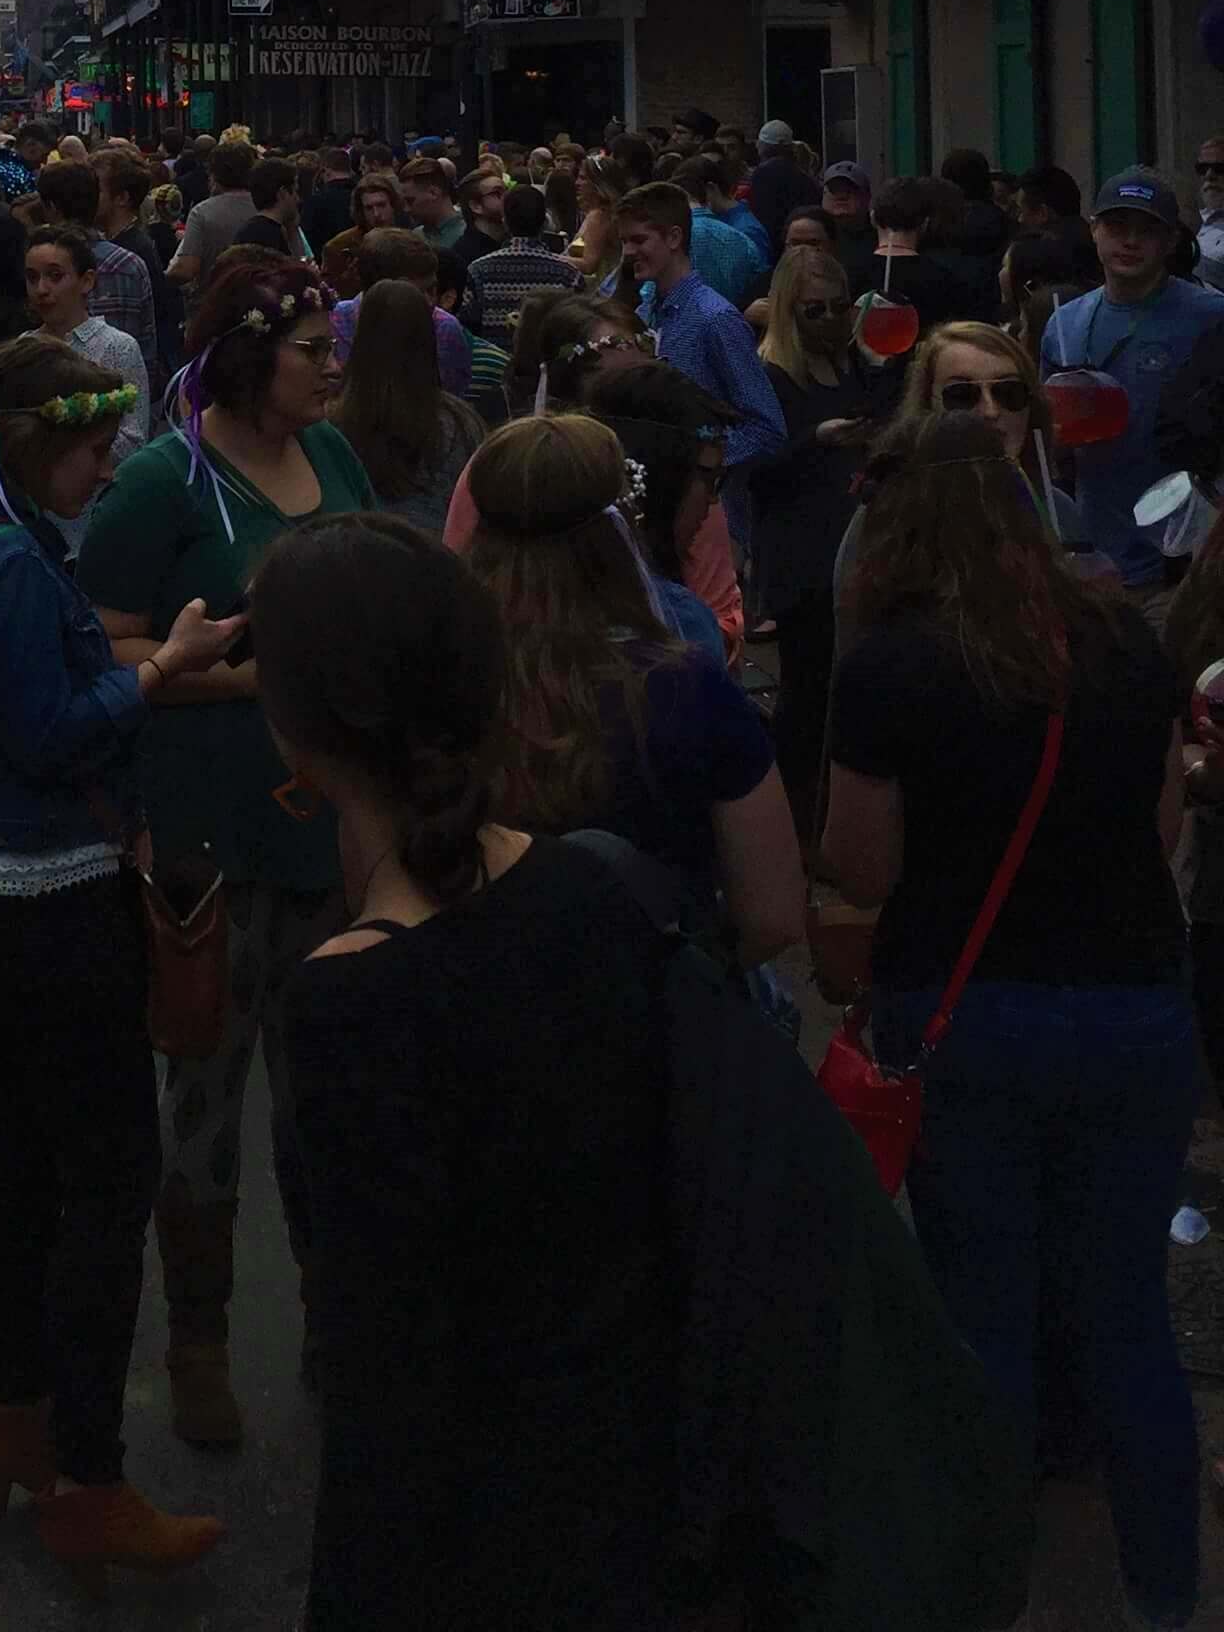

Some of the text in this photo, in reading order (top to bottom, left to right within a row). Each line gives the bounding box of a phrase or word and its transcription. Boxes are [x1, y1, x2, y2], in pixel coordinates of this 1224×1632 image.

[337, 24, 432, 41] BOURBON
[274, 42, 409, 51] DEDICATED TO THE
[389, 48, 432, 77] JAZZ
